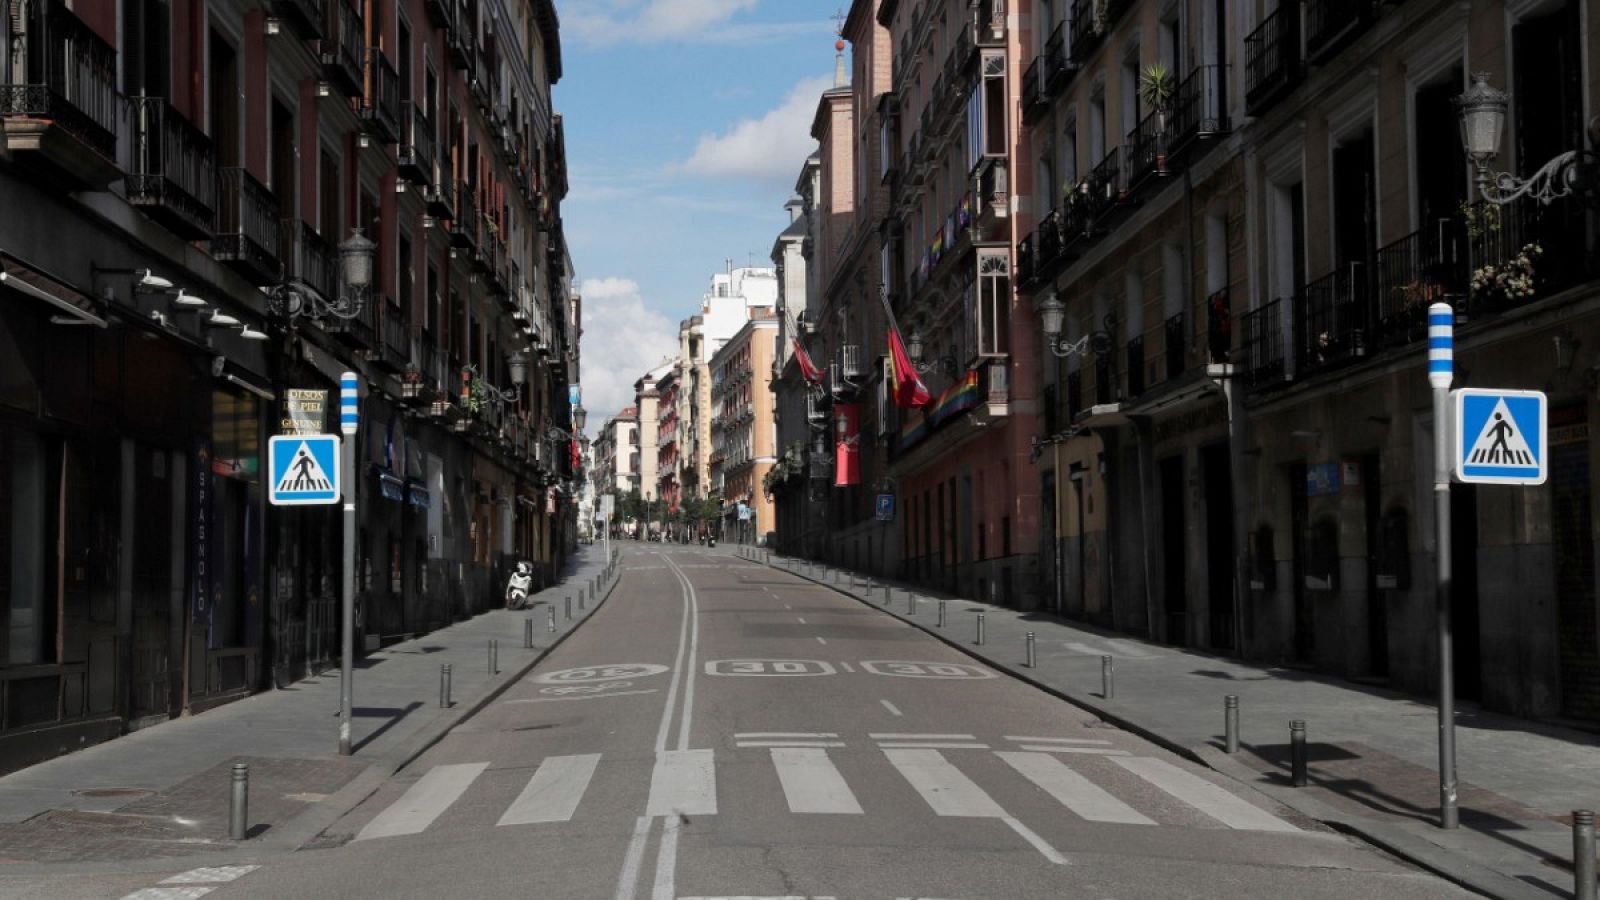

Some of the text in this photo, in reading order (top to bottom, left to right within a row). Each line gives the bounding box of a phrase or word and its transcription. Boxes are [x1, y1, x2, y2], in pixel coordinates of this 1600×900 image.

[300, 401, 322, 411] PIEL
[197, 471, 206, 612] SPAGNOLO
[733, 662, 807, 672] 30
[889, 664, 968, 676] 30
